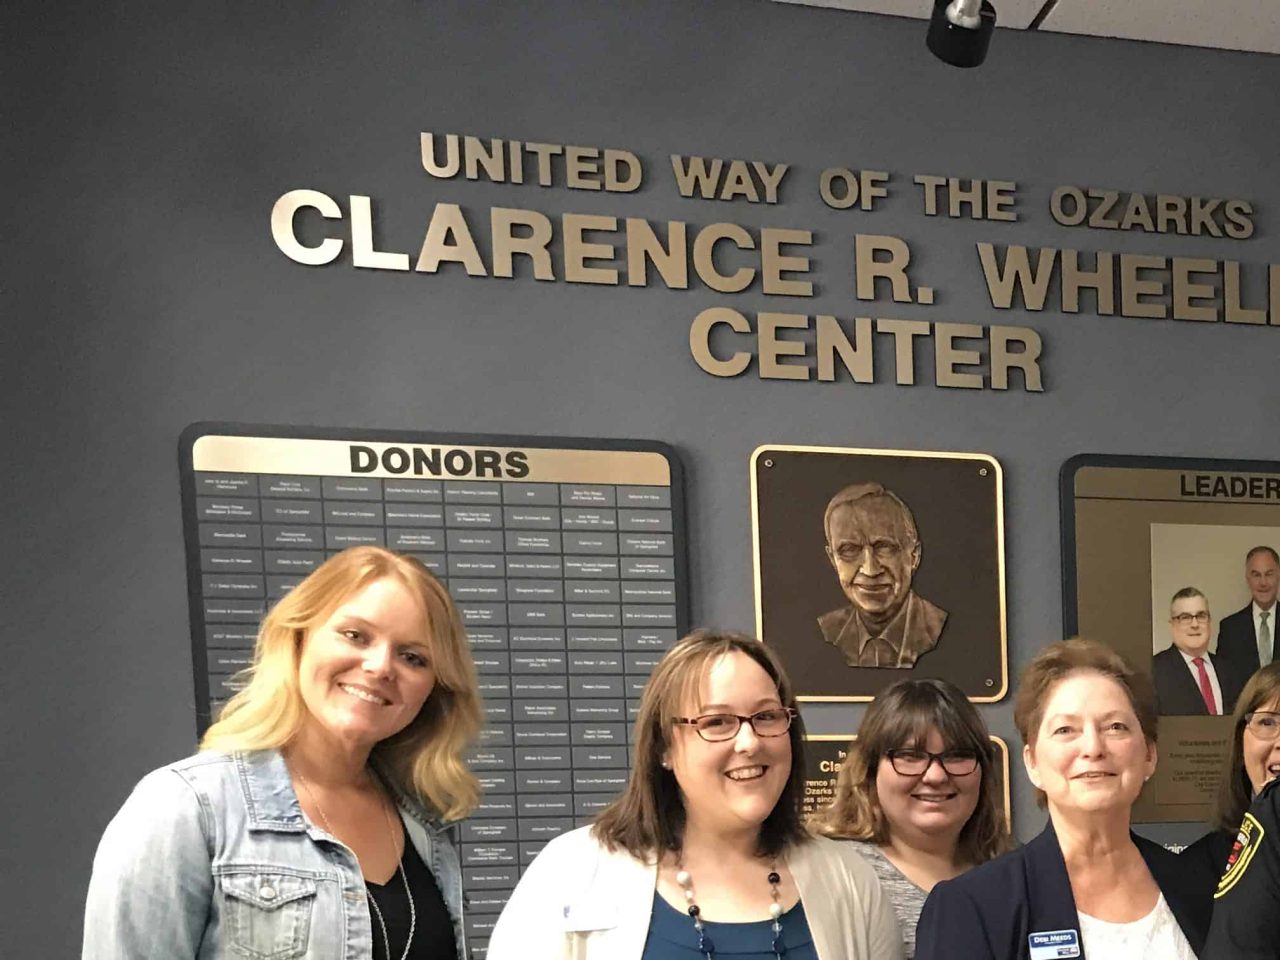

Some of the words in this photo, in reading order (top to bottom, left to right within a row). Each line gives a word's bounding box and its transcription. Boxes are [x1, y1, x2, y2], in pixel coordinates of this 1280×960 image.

[420, 131, 643, 193] UNITED
[670, 153, 789, 204] WAY
[819, 166, 889, 211] OF
[914, 174, 1018, 222] THE
[1050, 185, 1255, 240] OZARKS
[270, 188, 814, 297] CLARENCE
[855, 233, 934, 305] R.
[689, 306, 1045, 393] CENTER
[349, 445, 530, 478] DONORS
[820, 760, 841, 773] Cla
[838, 750, 847, 758] In
[805, 787, 833, 796] Ozarks
